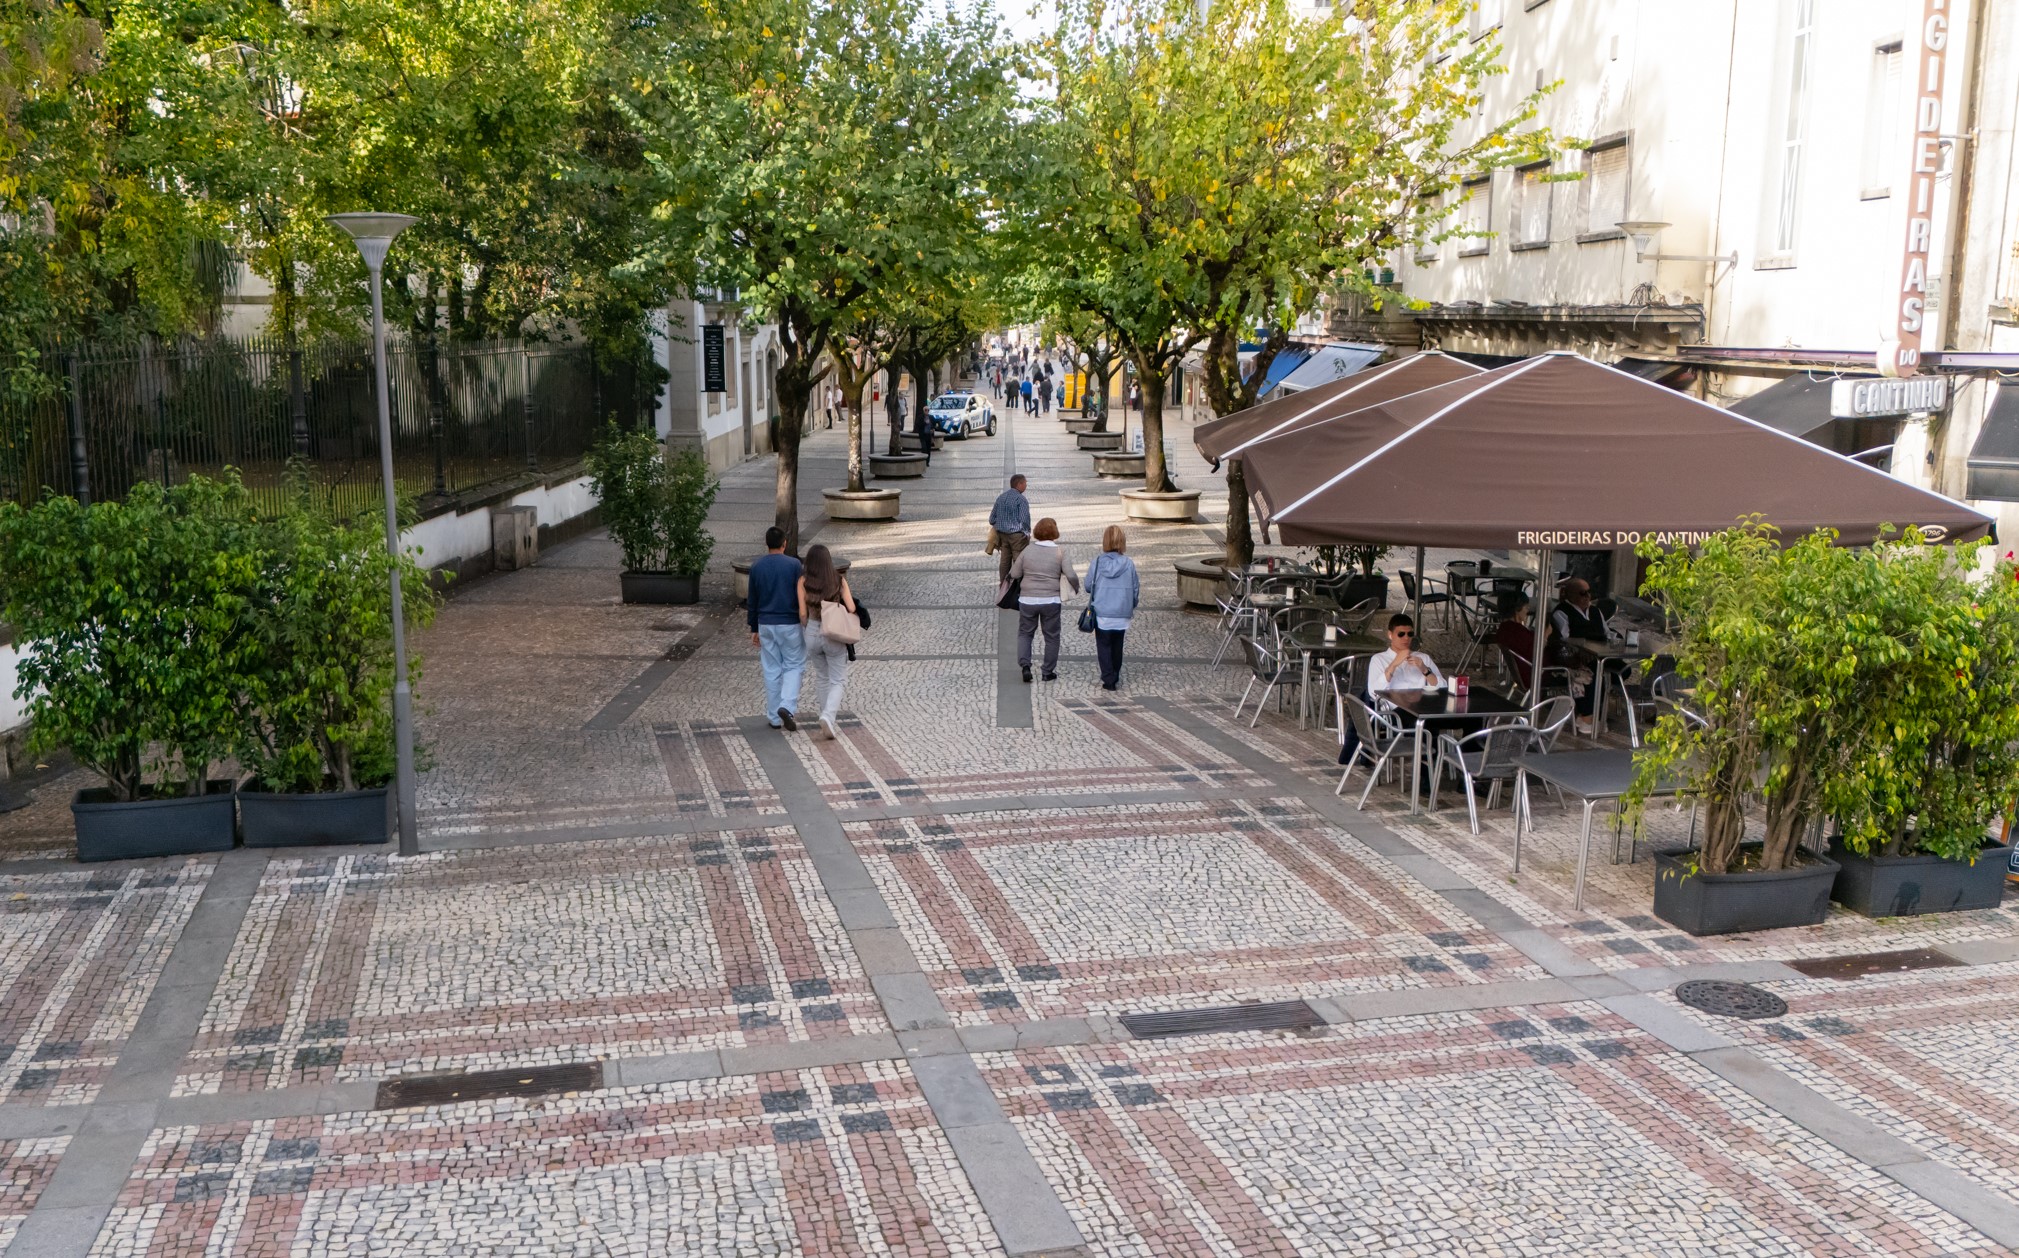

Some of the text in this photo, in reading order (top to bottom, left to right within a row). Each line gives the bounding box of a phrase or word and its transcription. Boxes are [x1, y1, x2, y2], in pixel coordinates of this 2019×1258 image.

[1902, 0, 1947, 332] GIDEIRAS
[1899, 349, 1917, 366] DO
[1855, 379, 1945, 413] CANTINHO
[1517, 531, 1611, 545] FRIGIDEIRAS
[1616, 531, 1641, 545] DO
